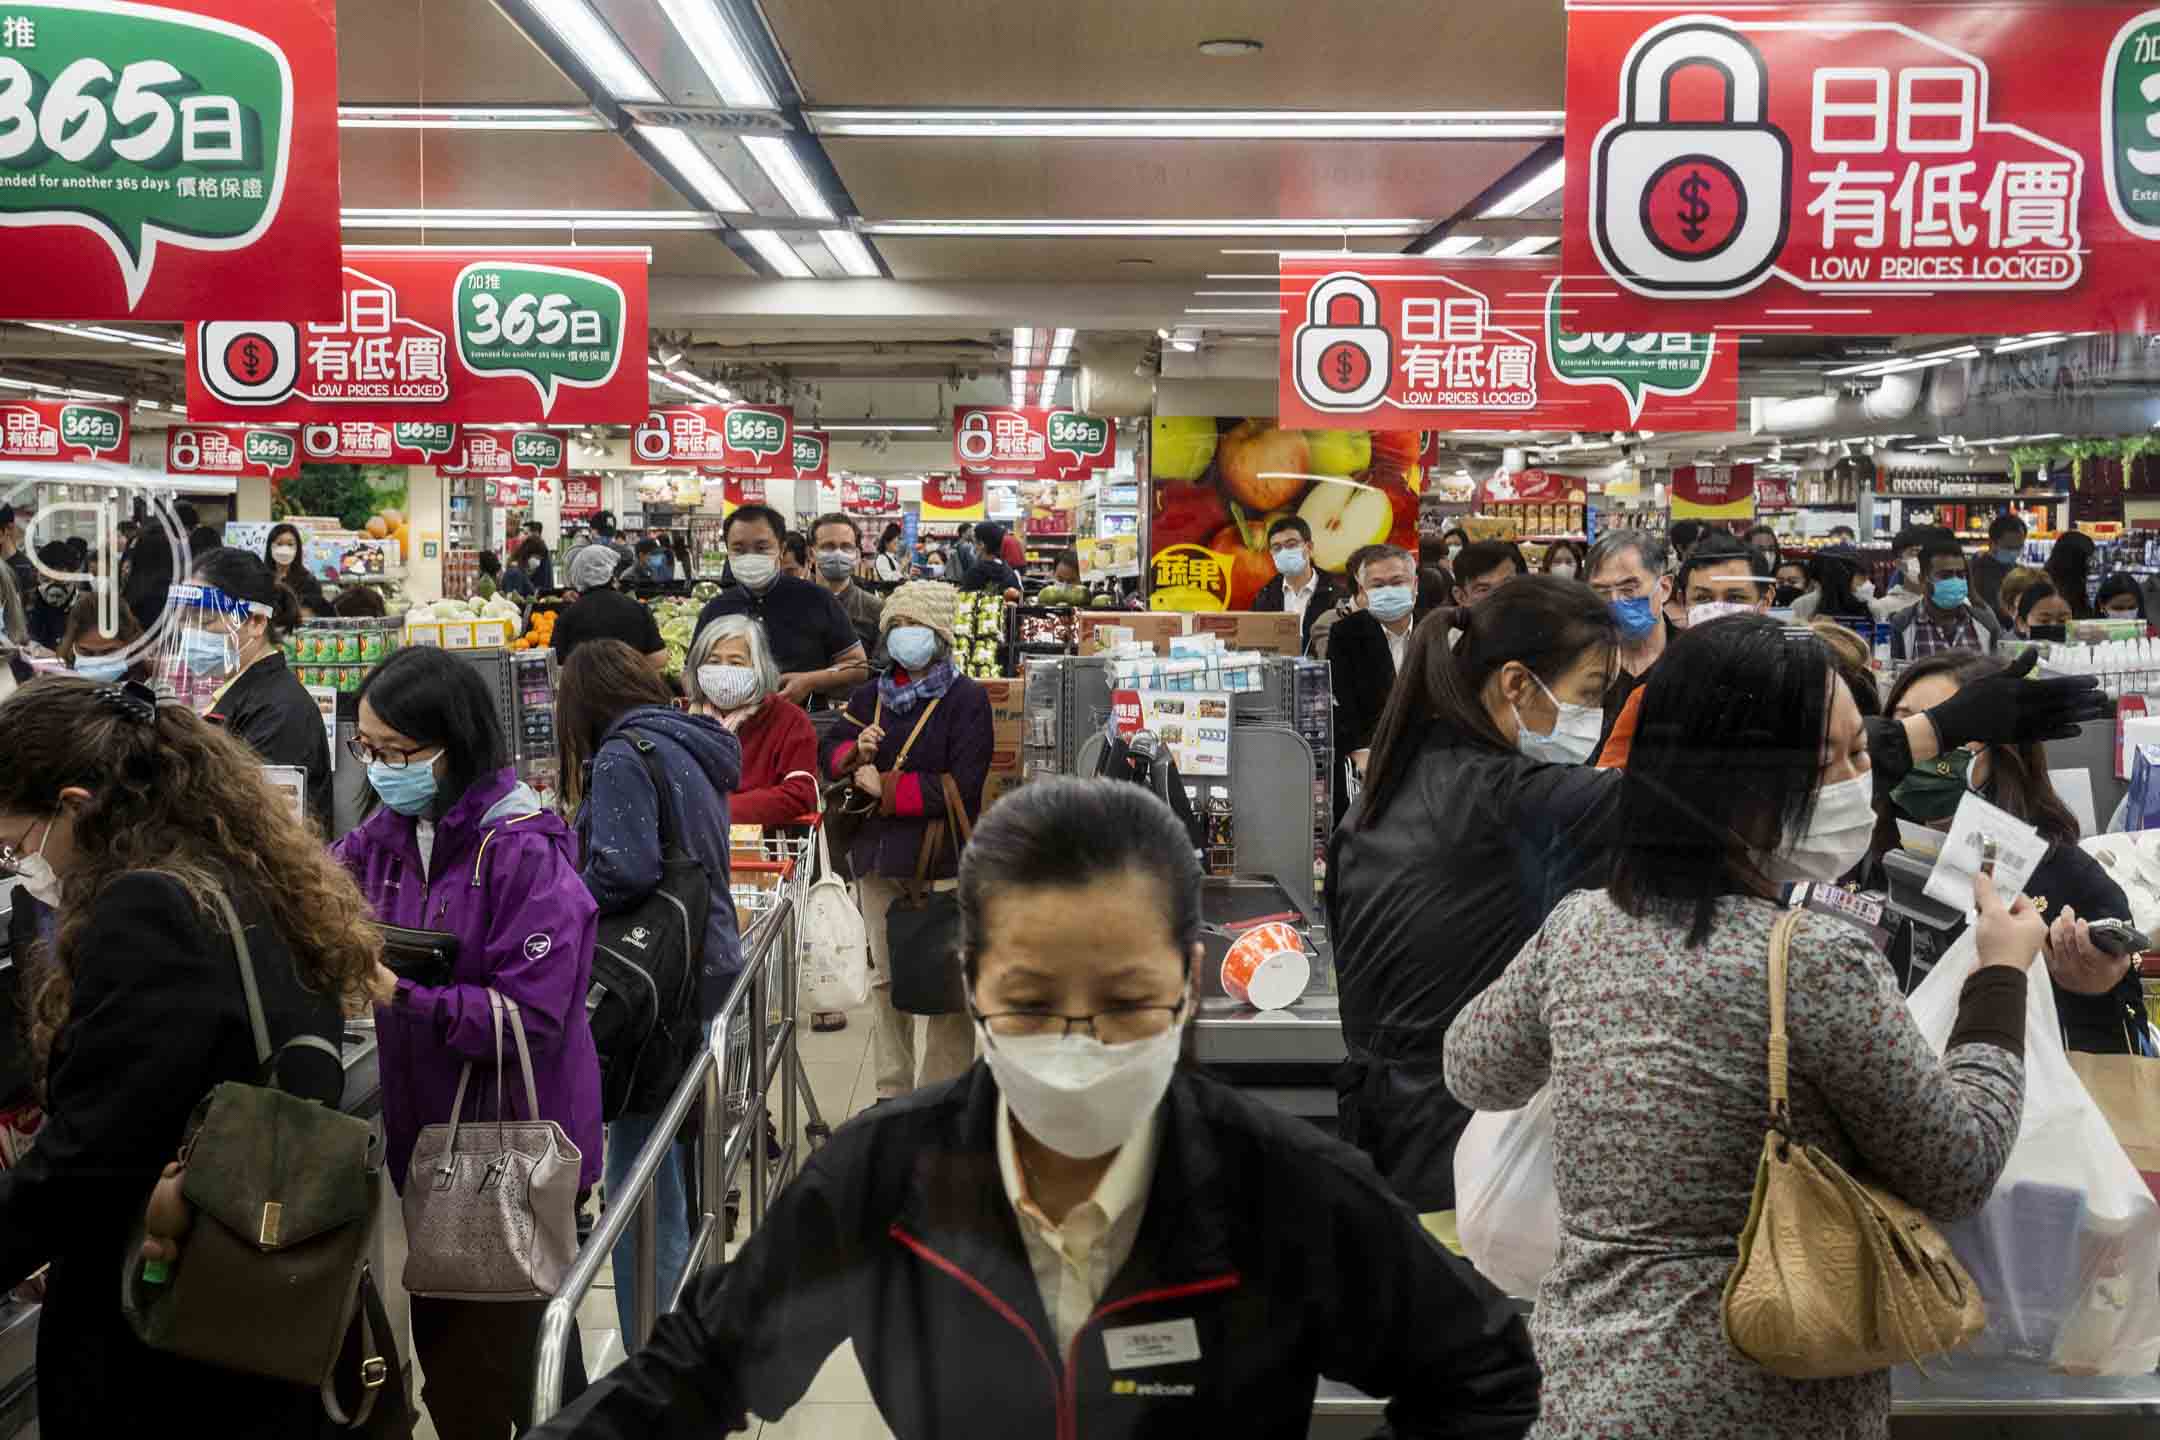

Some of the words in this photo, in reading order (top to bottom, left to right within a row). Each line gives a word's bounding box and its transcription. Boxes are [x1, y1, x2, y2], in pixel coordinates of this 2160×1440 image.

[1811, 67, 1976, 153] 日日
[40, 174, 58, 188] for
[62, 176, 112, 189] another
[117, 177, 138, 190] 365
[141, 176, 171, 190] days
[176, 177, 264, 198] 價格保證
[1807, 160, 2071, 249] 有低價
[1811, 257, 1870, 280] LOW
[1880, 257, 1963, 280] PRICES
[1973, 257, 2069, 280] LOCKED
[466, 293, 601, 345] 365日
[1402, 298, 1483, 341] 日日
[308, 336, 442, 381] 有低價
[1400, 344, 1531, 389] 有低價
[312, 385, 342, 396] LOW
[348, 385, 389, 396] PRICES
[394, 385, 441, 396] LOCKED
[1403, 392, 1433, 404] LOW
[1438, 392, 1478, 404] PRICES
[1483, 392, 1531, 404] LOCKED
[8, 413, 39, 430] 日日
[673, 418, 704, 434] 日日
[996, 419, 1025, 435] 日日
[1156, 552, 1219, 592] 蔬果
